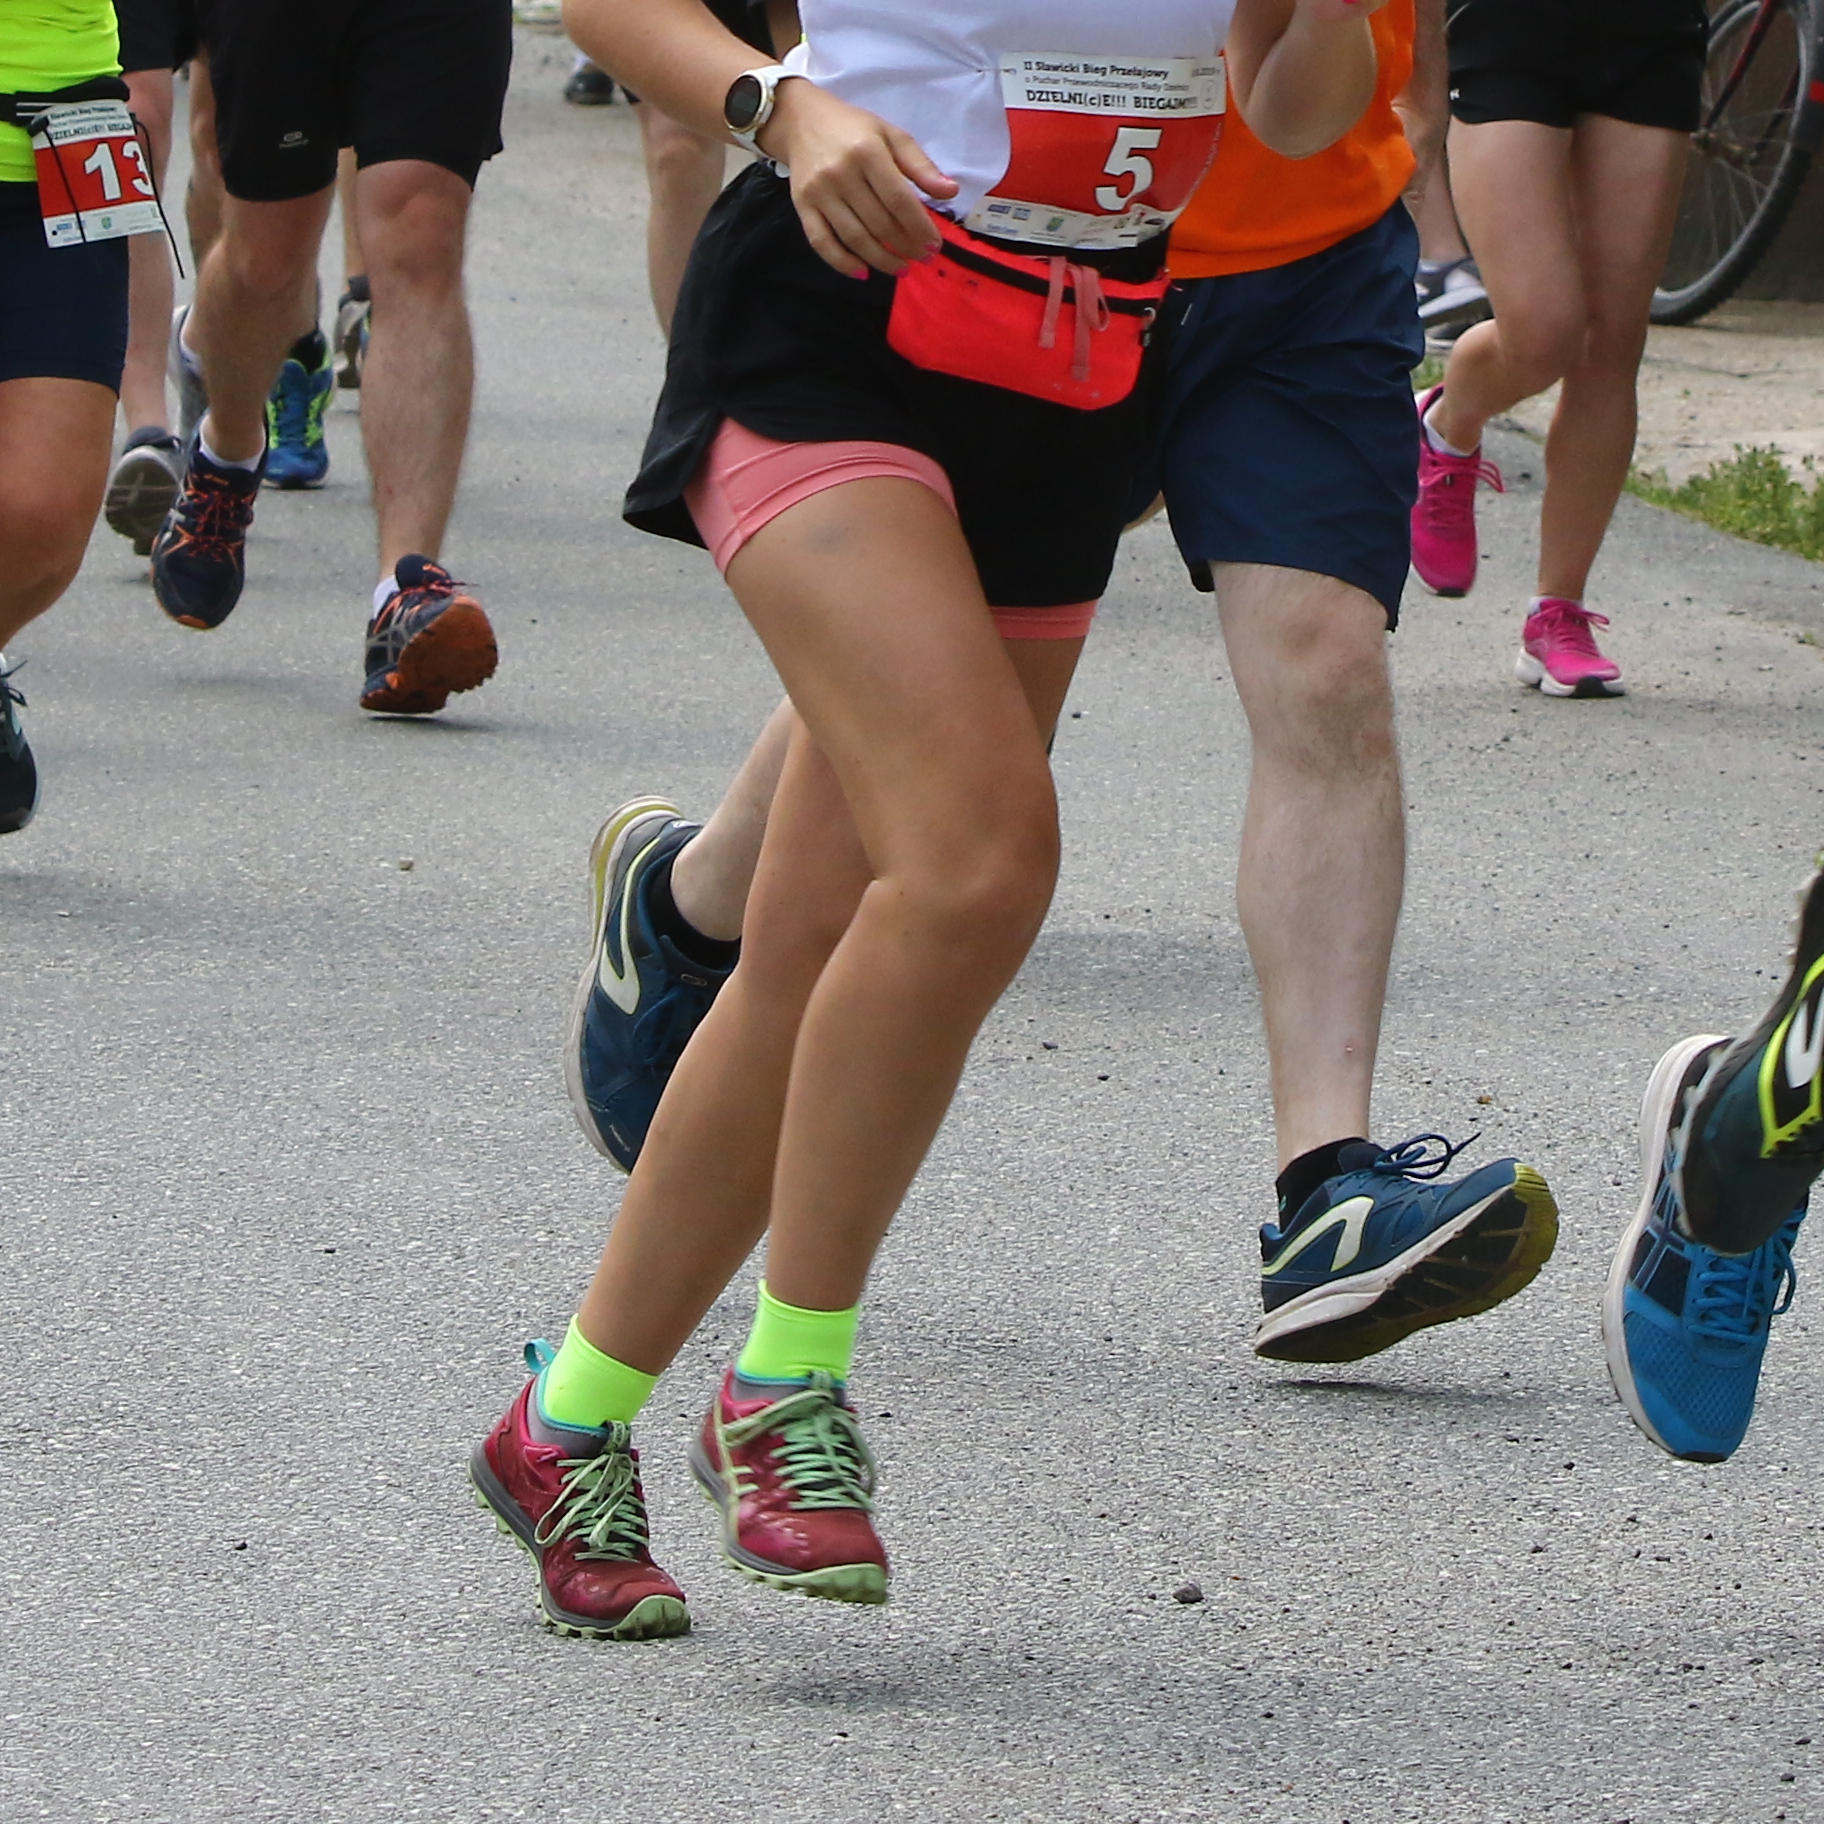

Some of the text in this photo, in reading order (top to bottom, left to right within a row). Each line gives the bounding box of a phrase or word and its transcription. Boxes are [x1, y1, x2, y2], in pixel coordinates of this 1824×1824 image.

[1024, 61, 1033, 71] II
[1083, 63, 1108, 77] Bieg
[1026, 89, 1127, 108] DZIELNI(c)E!!!
[84, 140, 155, 201] 13
[1095, 127, 1163, 211] 5
